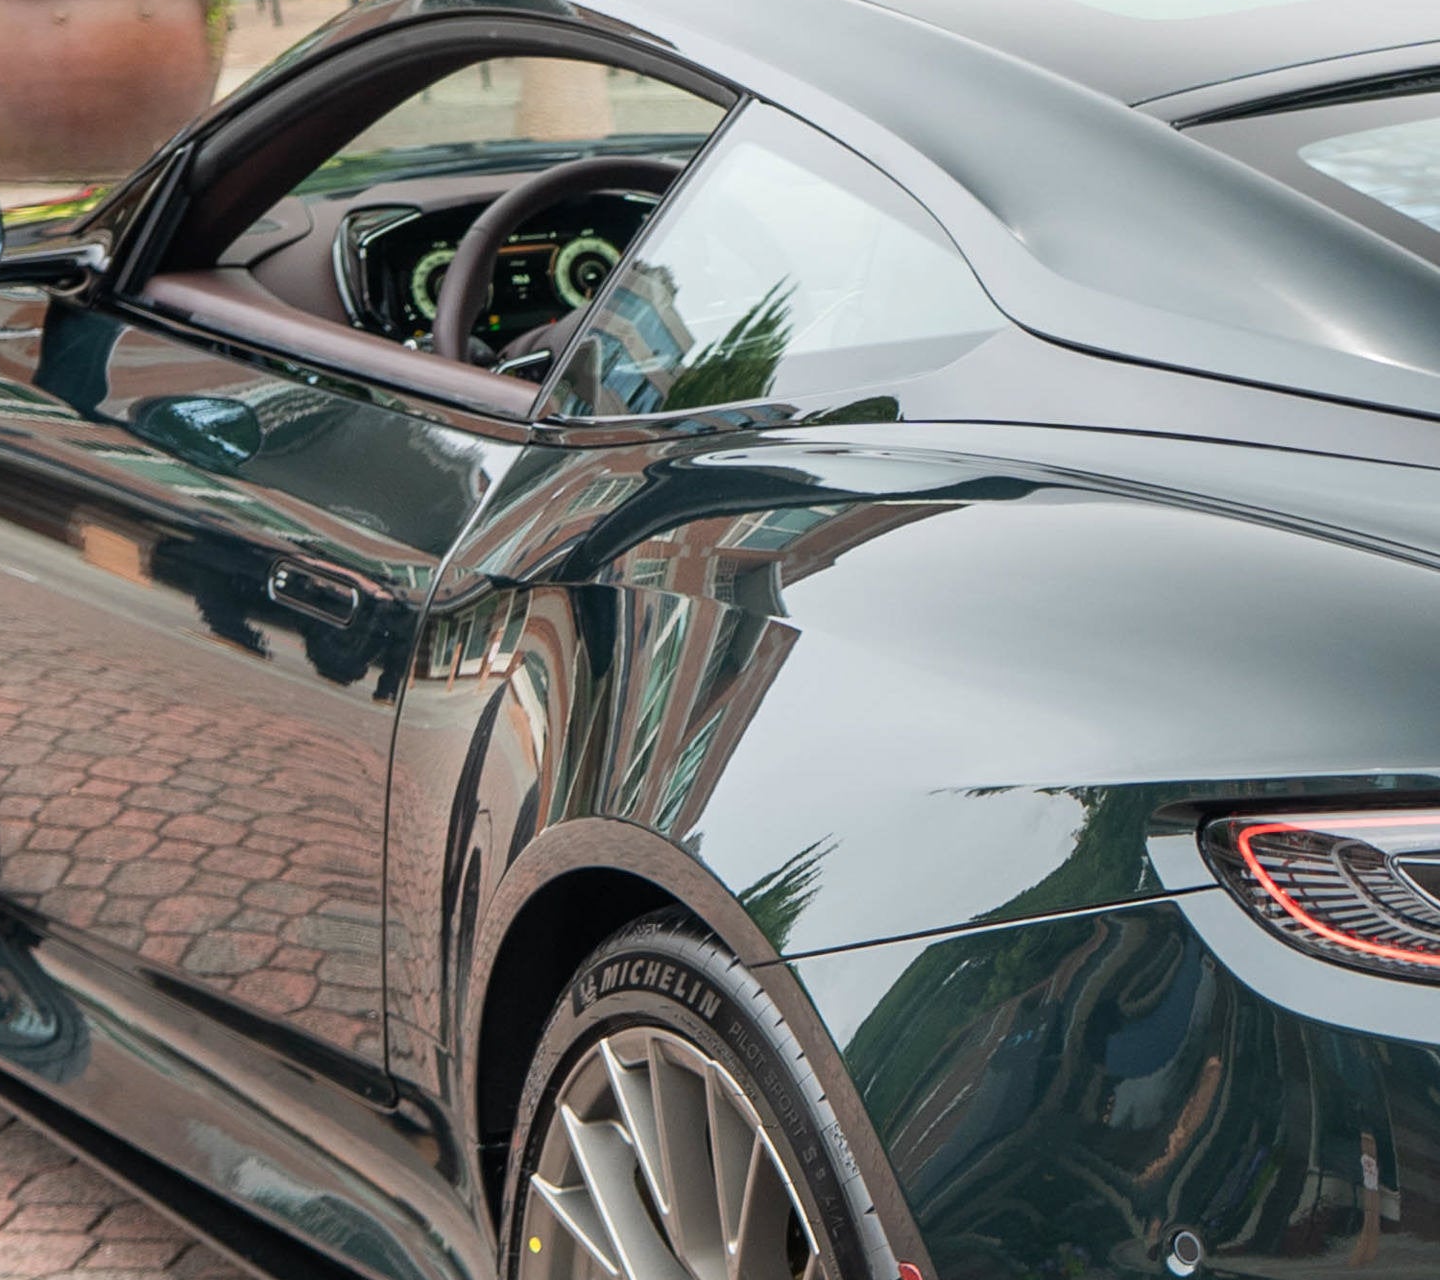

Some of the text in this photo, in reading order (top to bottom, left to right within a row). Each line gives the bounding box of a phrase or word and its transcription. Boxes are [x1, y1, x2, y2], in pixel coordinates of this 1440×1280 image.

[599, 958, 721, 1020] MICHELIN
[727, 1021, 767, 1068] PILOT
[763, 1070, 808, 1138] SPORT
